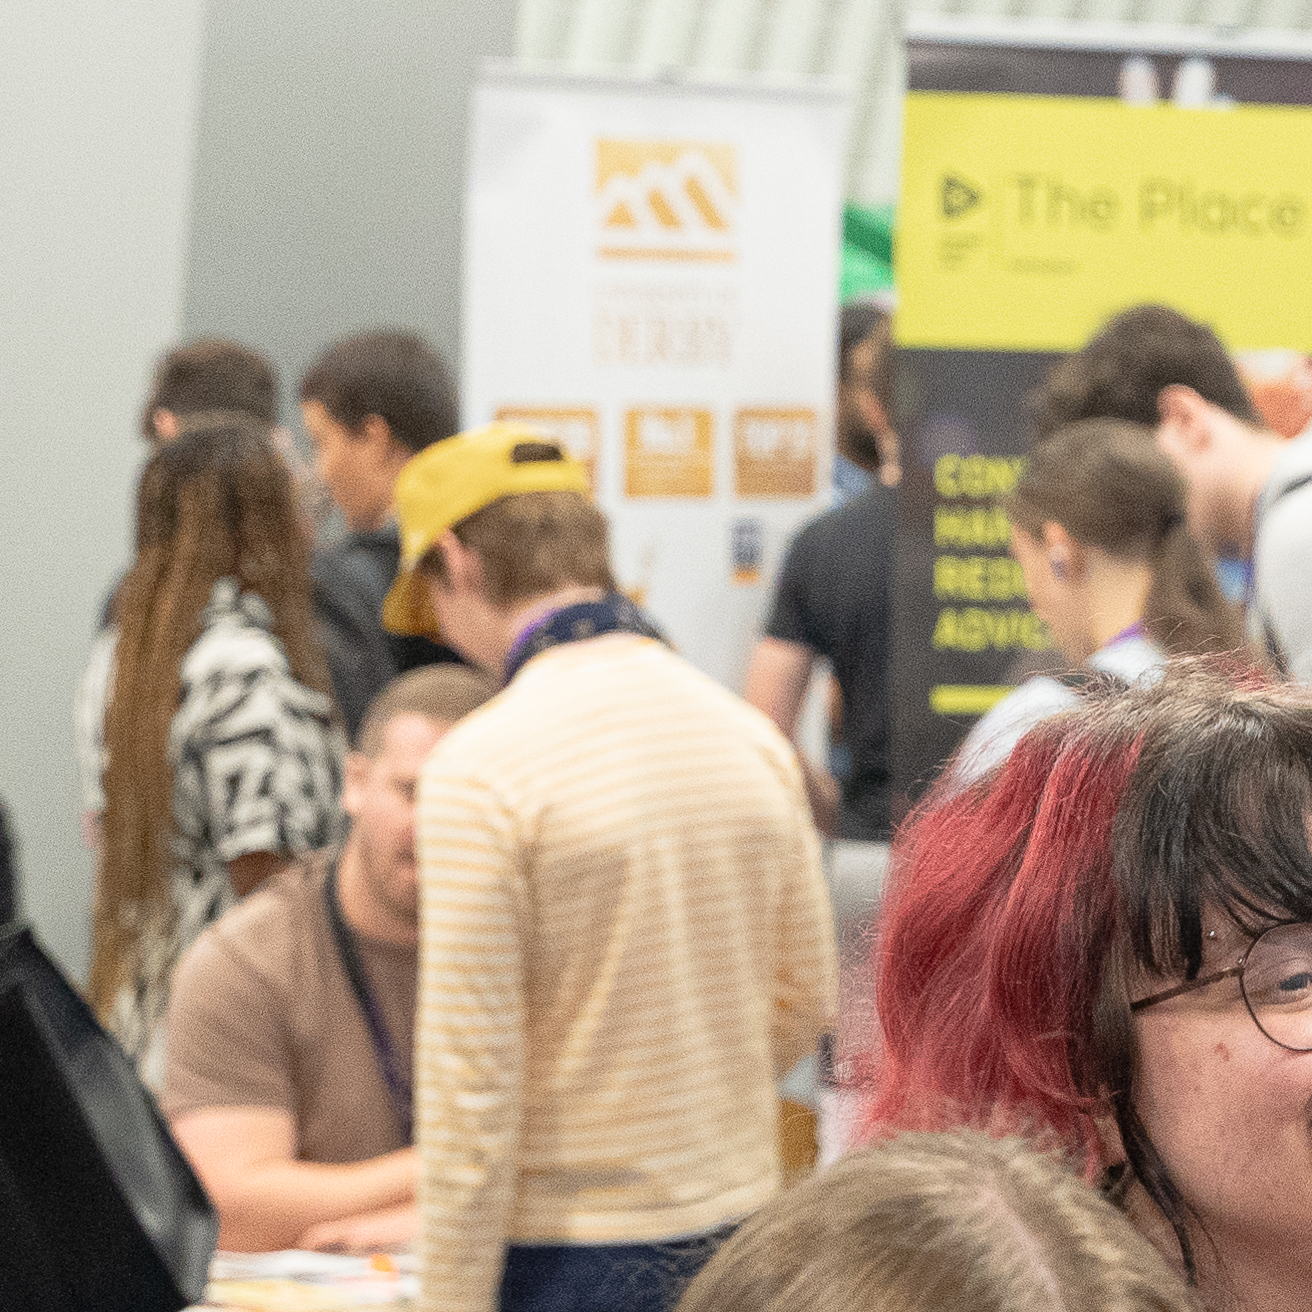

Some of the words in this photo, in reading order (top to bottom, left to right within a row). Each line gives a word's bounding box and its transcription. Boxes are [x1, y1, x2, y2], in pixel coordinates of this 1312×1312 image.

[1009, 173, 1119, 230] The
[1140, 178, 1307, 236] Place
[932, 607, 1053, 652] ADVIC
